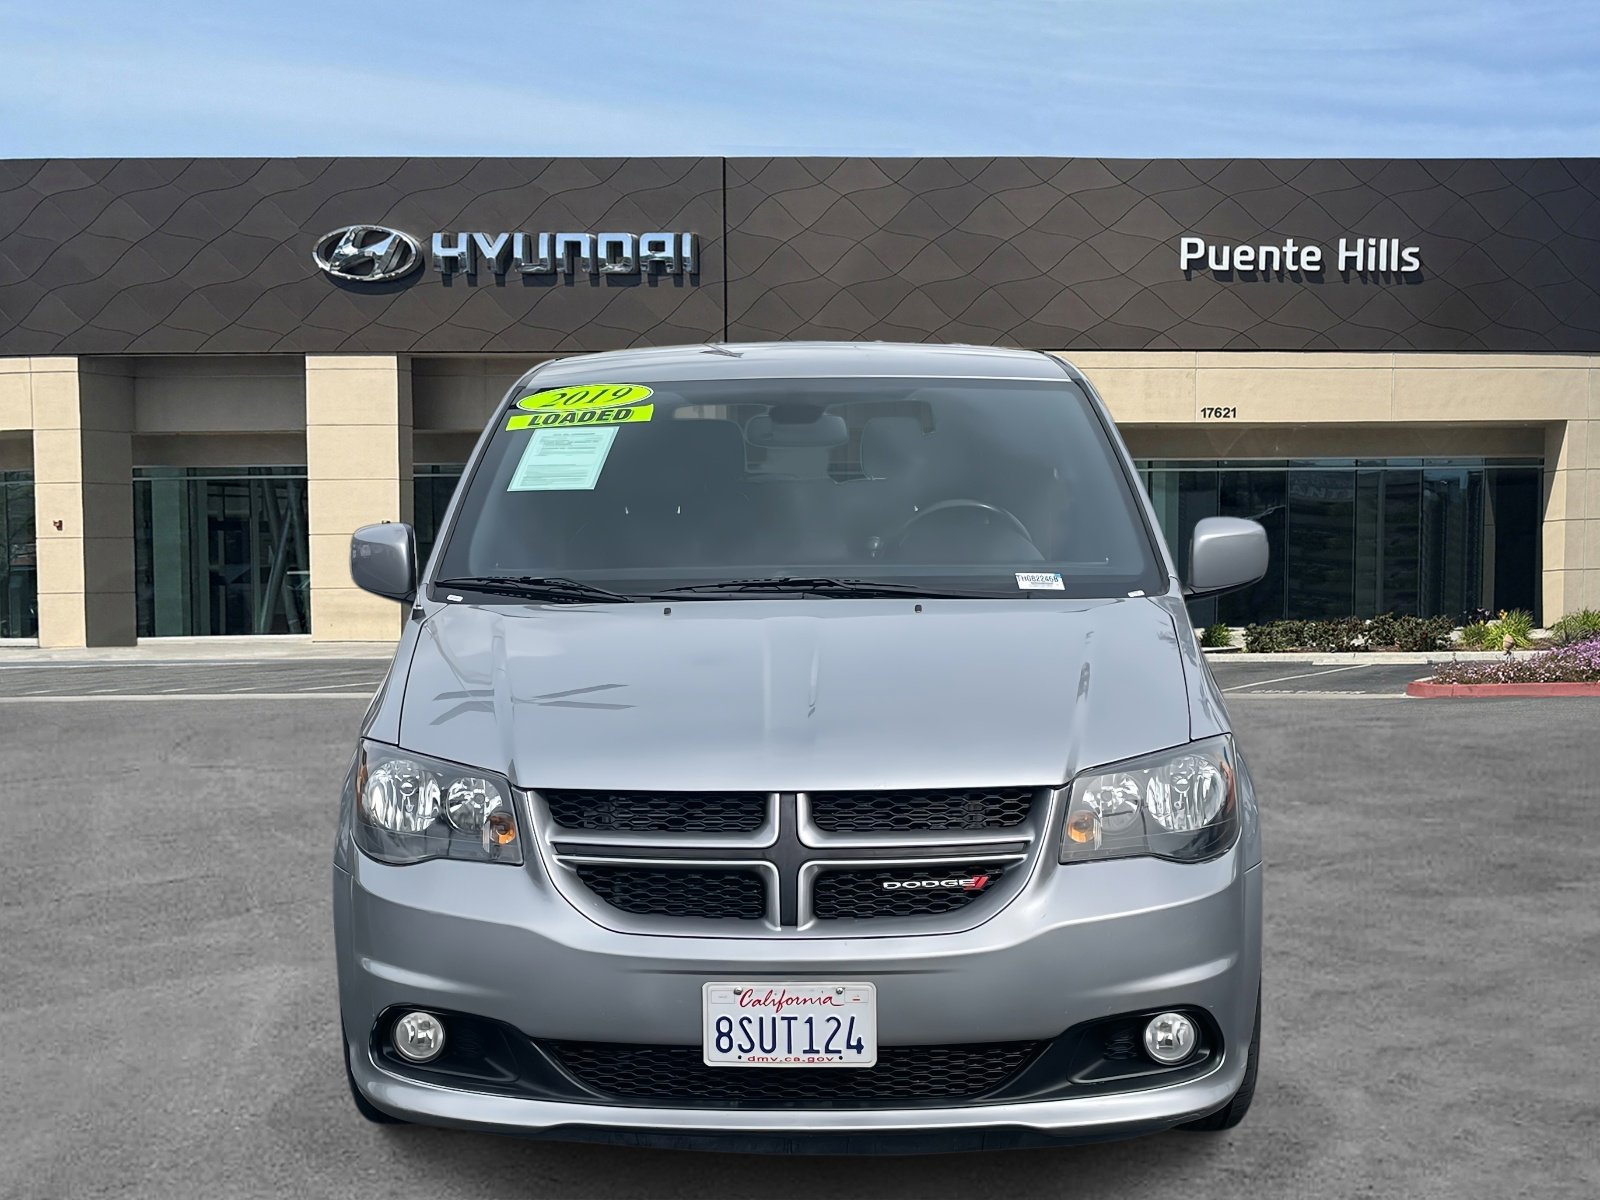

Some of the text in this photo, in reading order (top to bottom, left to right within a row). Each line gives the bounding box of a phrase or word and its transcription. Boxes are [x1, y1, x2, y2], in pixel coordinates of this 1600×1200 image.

[432, 232, 695, 275] HYUNDAI
[1180, 237, 1420, 272] Puente Hills
[539, 387, 633, 408] 2019
[528, 408, 634, 427] LOADED
[1200, 407, 1237, 419] 17621
[883, 879, 976, 889] DODGE
[739, 988, 845, 1013] California
[715, 1016, 865, 1055] 8SUT124
[747, 1056, 835, 1064] dmv.ca.gov
